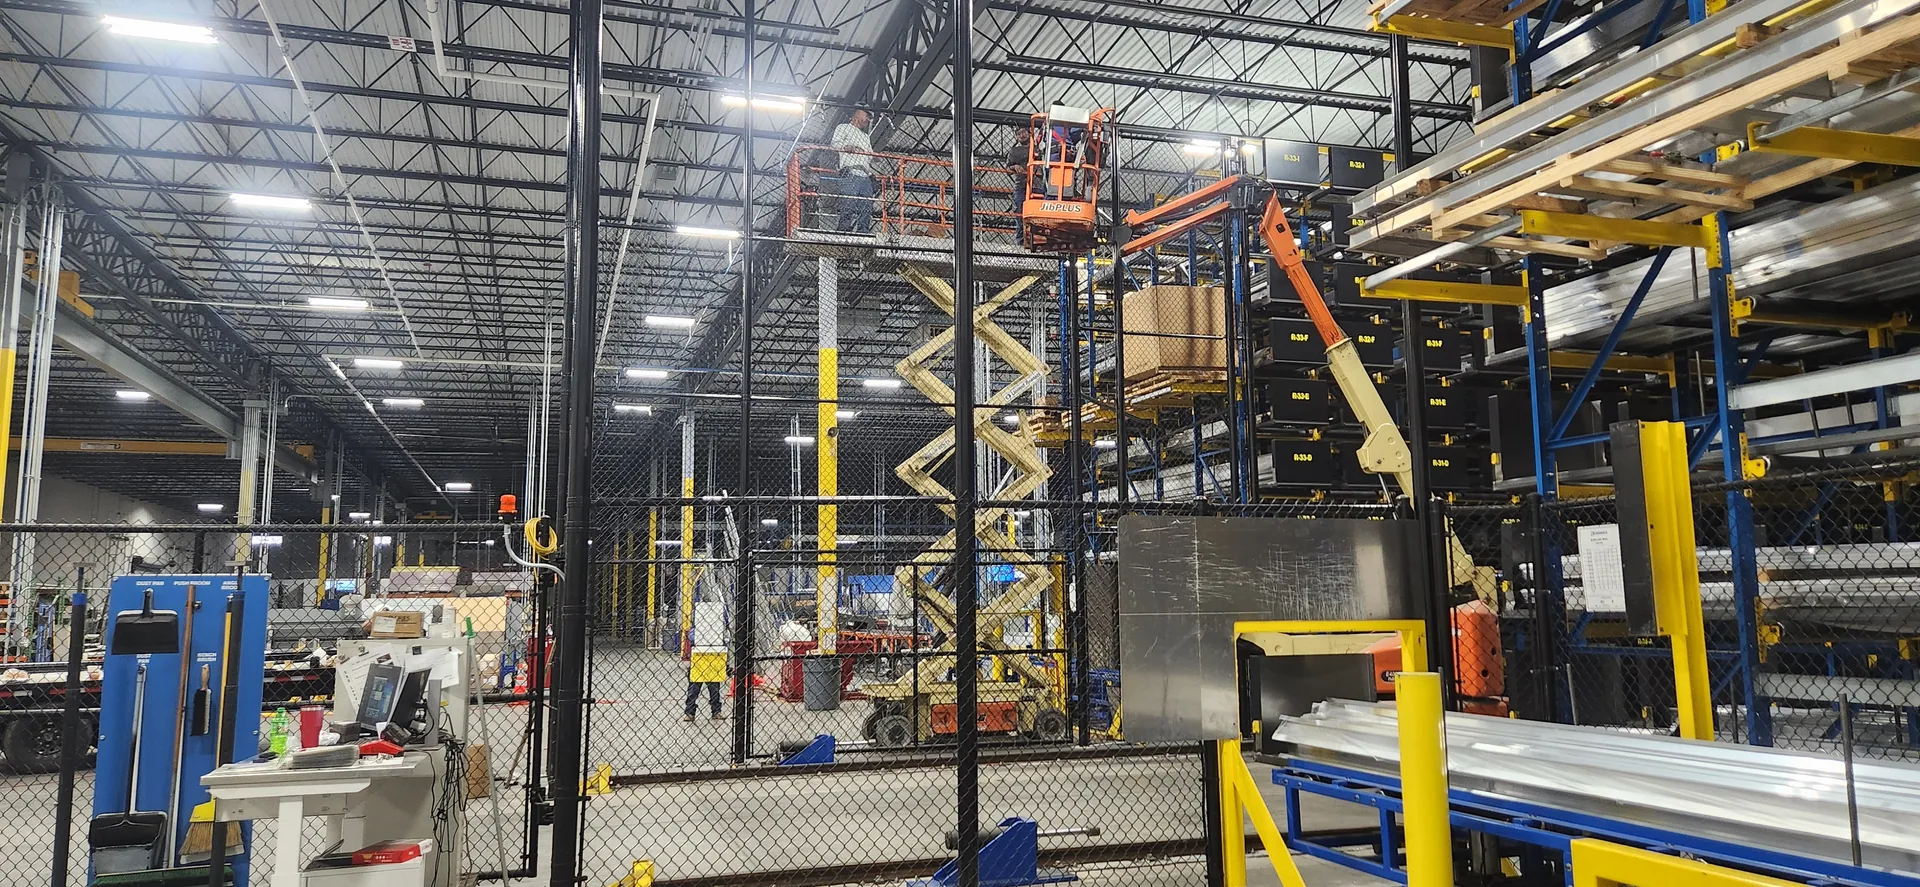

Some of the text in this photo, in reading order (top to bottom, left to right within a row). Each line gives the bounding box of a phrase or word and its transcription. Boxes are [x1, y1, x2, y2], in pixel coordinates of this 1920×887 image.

[1040, 202, 1082, 213] JibPLUS
[1290, 333, 1309, 342] R-33-F
[1358, 335, 1376, 344] R-32-F
